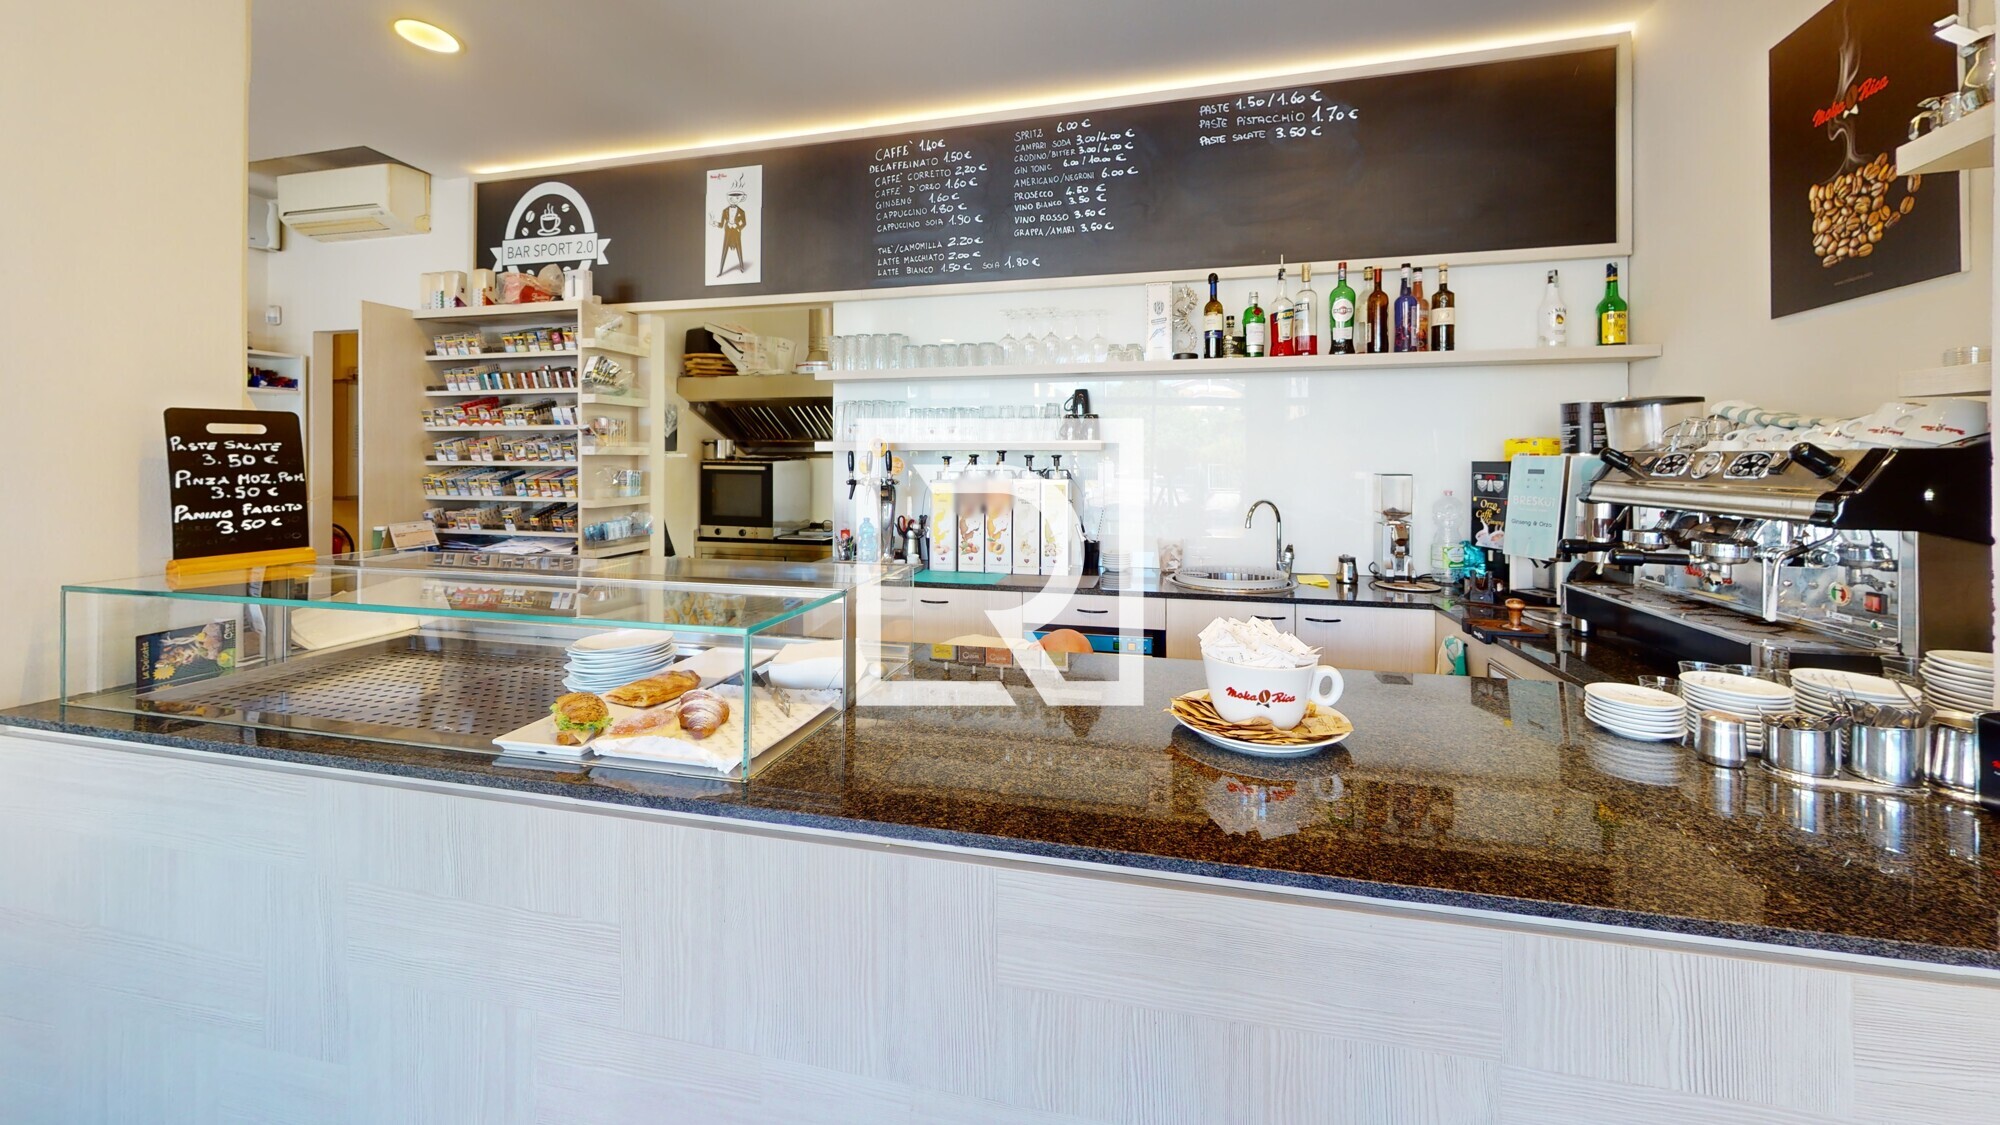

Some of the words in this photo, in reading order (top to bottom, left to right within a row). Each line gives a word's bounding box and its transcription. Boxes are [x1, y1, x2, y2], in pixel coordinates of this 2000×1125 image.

[1858, 75, 1889, 101] Rica
[1199, 103, 1230, 116] PASTE
[1199, 118, 1228, 128] PASTE
[1312, 106, 1345, 122] 1.70
[1014, 129, 1044, 142] SPRITZ
[1056, 122, 1078, 133] 6.00
[1199, 135, 1227, 146] PASTE
[1232, 130, 1266, 142] SALATE
[1275, 127, 1306, 138] 3.50
[1015, 142, 1046, 152] CAMPARI
[1052, 138, 1072, 148] SODA
[869, 158, 939, 174] DECAFFEINATO
[1014, 166, 1028, 175] GIN
[1031, 164, 1052, 173] TONIC
[1101, 168, 1124, 178] 6.00
[908, 169, 952, 181] CORRETTO
[1014, 190, 1054, 200] PROSECCO
[1066, 185, 1088, 196] 4.50
[876, 197, 912, 210] GINSENG
[928, 193, 950, 204] 1.60
[1036, 200, 1062, 209] BIANCO
[1068, 196, 1090, 205] 3.50
[876, 208, 928, 221] CAPPUCCINO
[1014, 216, 1036, 224] VINO
[1040, 214, 1069, 222] ROSSO
[1074, 210, 1096, 219] 3.50
[876, 221, 920, 232] CAPPUCCINO
[948, 214, 971, 226] 1.90
[1080, 222, 1102, 232] 3.50
[507, 246, 530, 259] BAR
[534, 242, 572, 257] SPORT
[576, 240, 594, 254] 2.0
[878, 256, 900, 266] LATTE
[904, 254, 944, 264] MACCHIATO
[948, 252, 970, 260] 2.00
[878, 267, 900, 276] LATTE
[906, 266, 934, 274] BIANCO
[940, 263, 960, 272] 1.50
[1004, 256, 1029, 268] 1.80
[170, 436, 218, 452] PASTE
[224, 440, 282, 452] SALATE
[202, 454, 256, 468] 3.50
[175, 470, 230, 488] PINZA
[211, 486, 260, 499] 3.50
[174, 504, 234, 523] PANINO
[242, 503, 303, 516] FARCITO
[216, 519, 266, 534] 3.50
[1511, 518, 1532, 528] Ginseng
[1226, 686, 1258, 701] Moka
[1272, 692, 1296, 703] Rica
